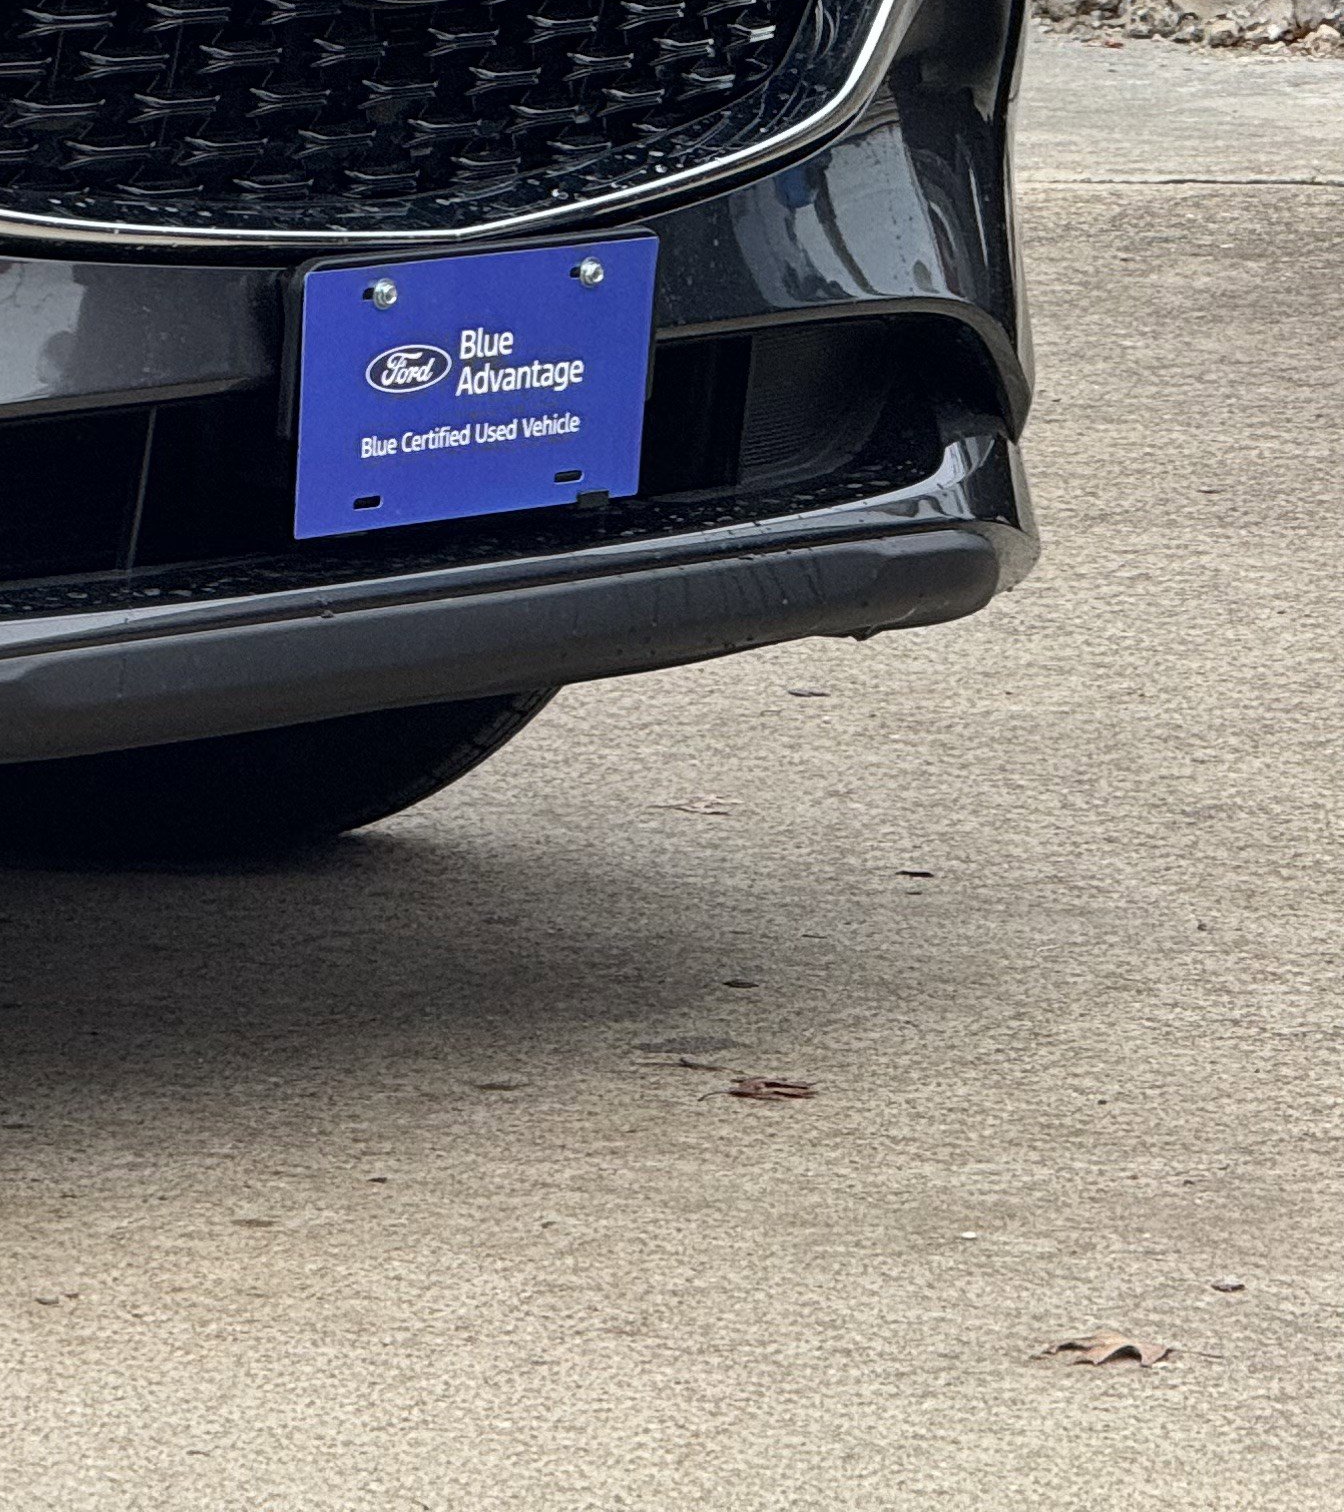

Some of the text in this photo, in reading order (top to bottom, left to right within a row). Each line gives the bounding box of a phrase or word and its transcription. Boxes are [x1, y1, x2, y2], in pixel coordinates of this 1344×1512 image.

[459, 327, 514, 360] Blue
[380, 351, 436, 387] Ford
[455, 359, 585, 397] Advantage
[360, 412, 581, 459] Blue Certified Used Vehicle
